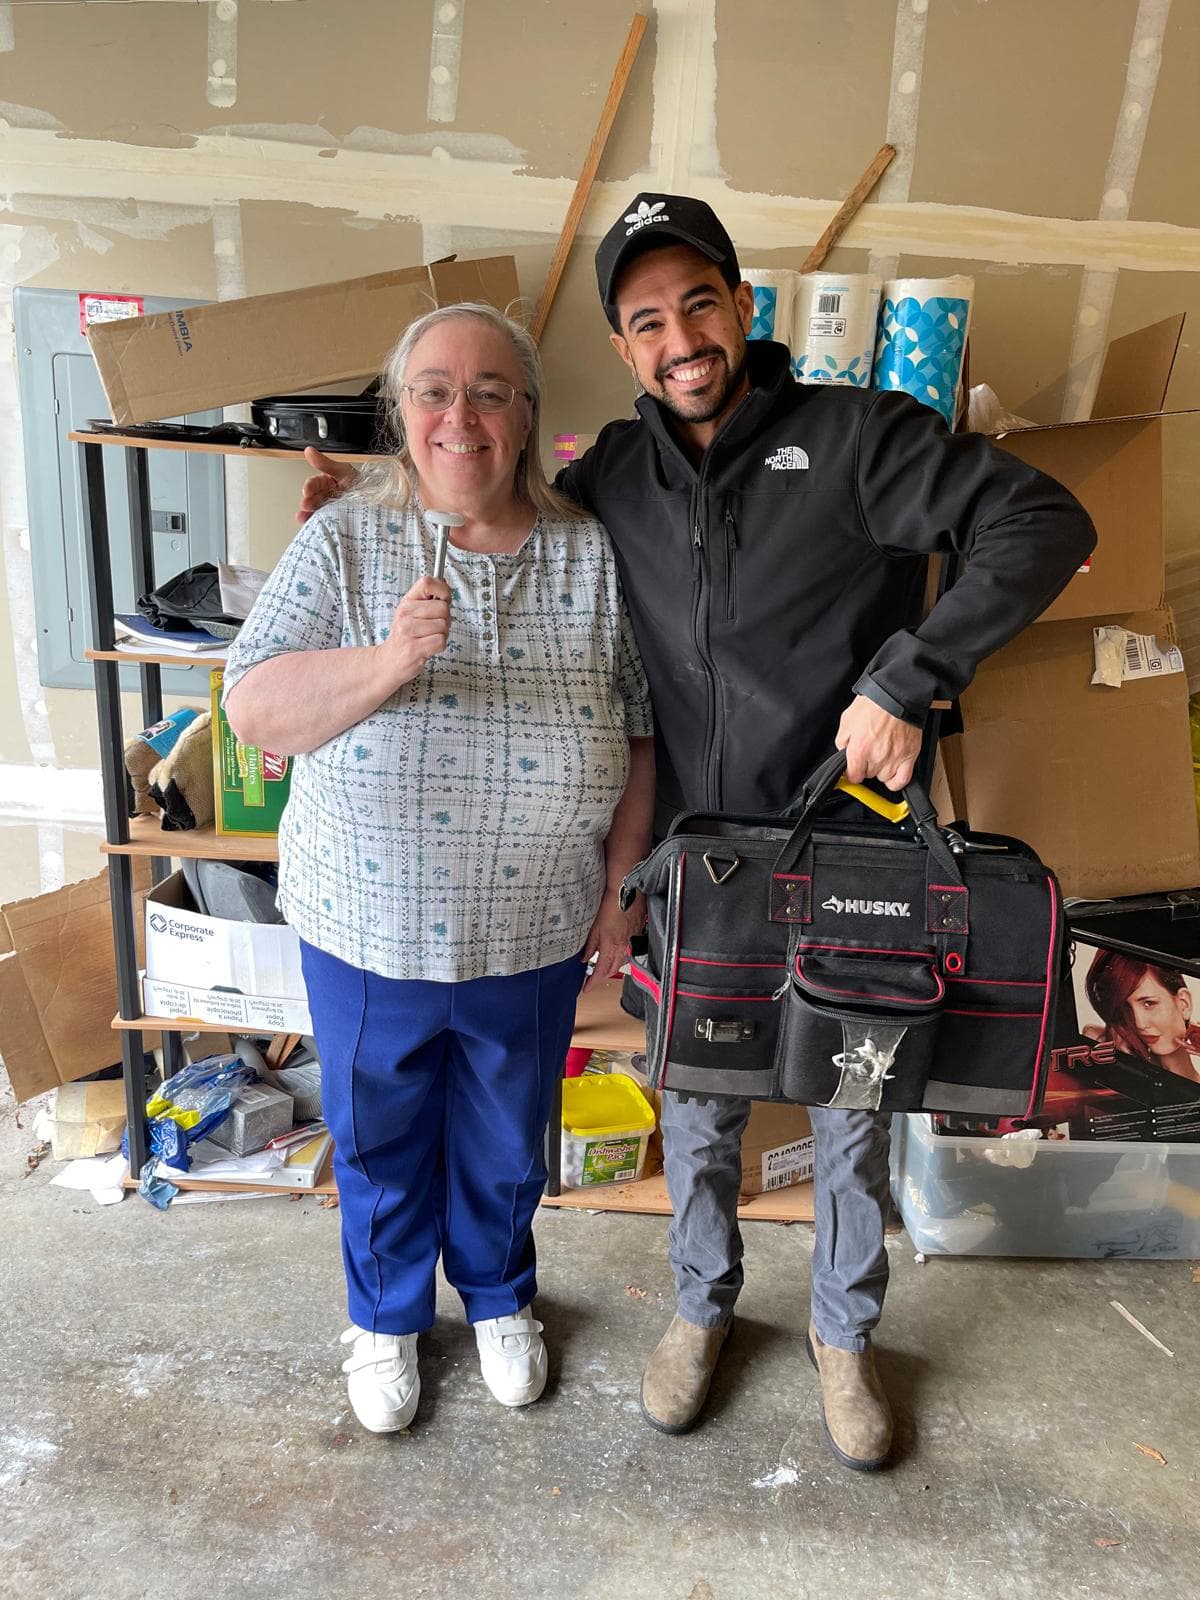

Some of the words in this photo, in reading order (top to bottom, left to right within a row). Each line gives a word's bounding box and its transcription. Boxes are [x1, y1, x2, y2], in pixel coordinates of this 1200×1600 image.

[625, 214, 670, 237] adidas
[776, 446, 793, 455] THE
[764, 454, 793, 466] NORTH
[771, 461, 793, 471] FACE
[248, 753, 258, 785] Halves
[168, 919, 215, 937] Corporate
[169, 927, 204, 943] Express
[170, 1008, 188, 1016] Papel
[207, 1007, 242, 1016] photocopie
[223, 1014, 243, 1023] Papier
[265, 1014, 284, 1022] Paper
[267, 1019, 285, 1028] Copy
[587, 1143, 639, 1156] Dishwasher
